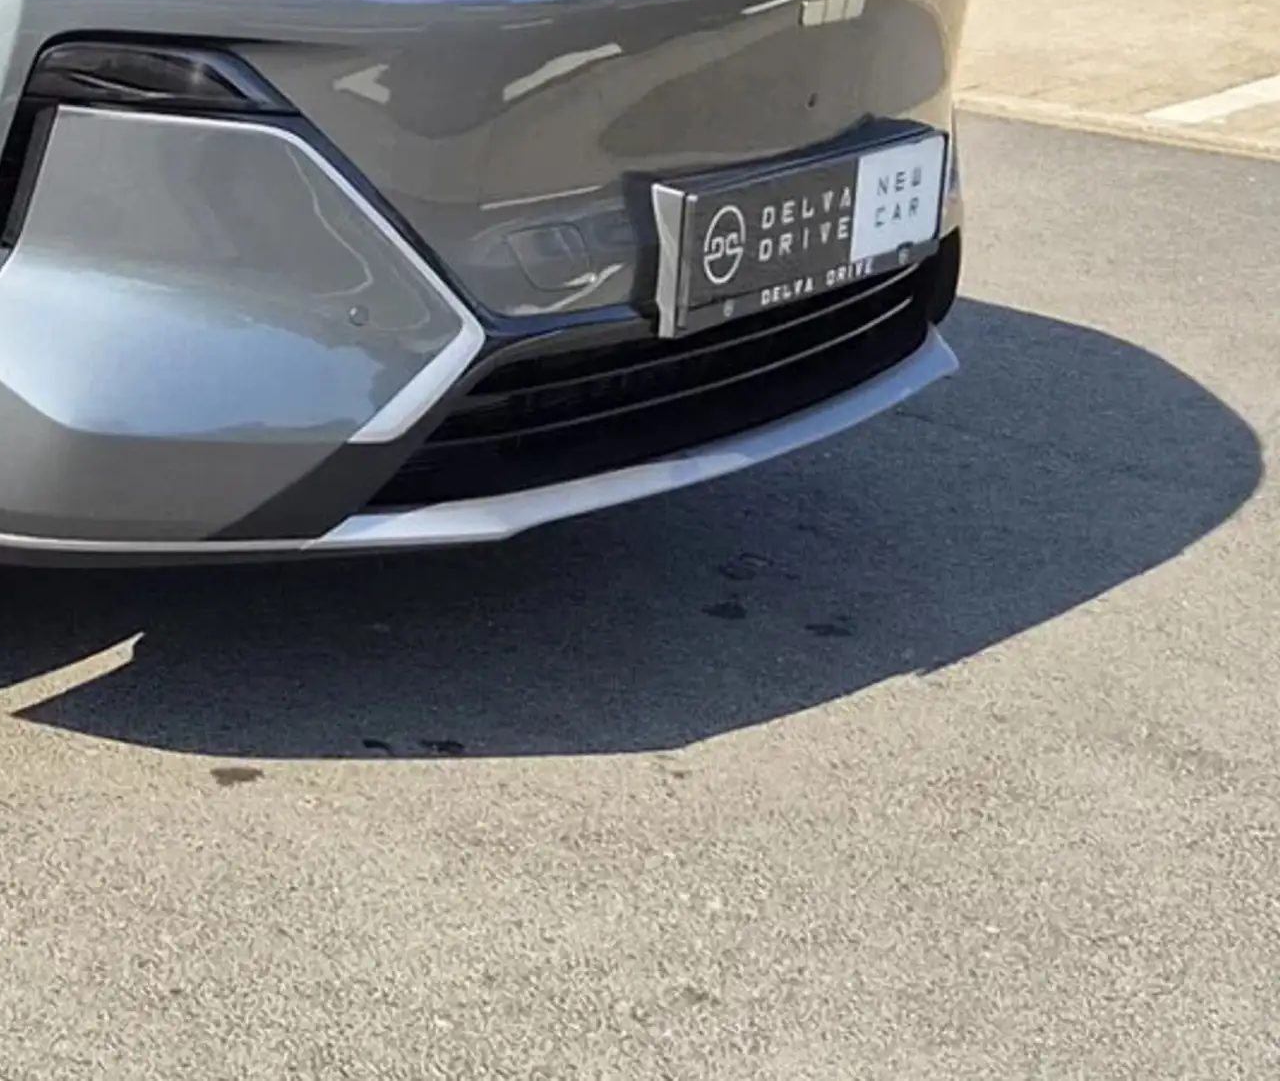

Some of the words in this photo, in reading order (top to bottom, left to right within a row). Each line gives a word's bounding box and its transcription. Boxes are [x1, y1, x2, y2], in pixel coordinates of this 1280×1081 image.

[875, 166, 922, 196] NEW
[760, 186, 852, 230] DELVA
[874, 197, 920, 228] CAR
[758, 216, 851, 262] DRIVE
[760, 278, 815, 306] DELVA
[826, 261, 874, 287] DRIVE
